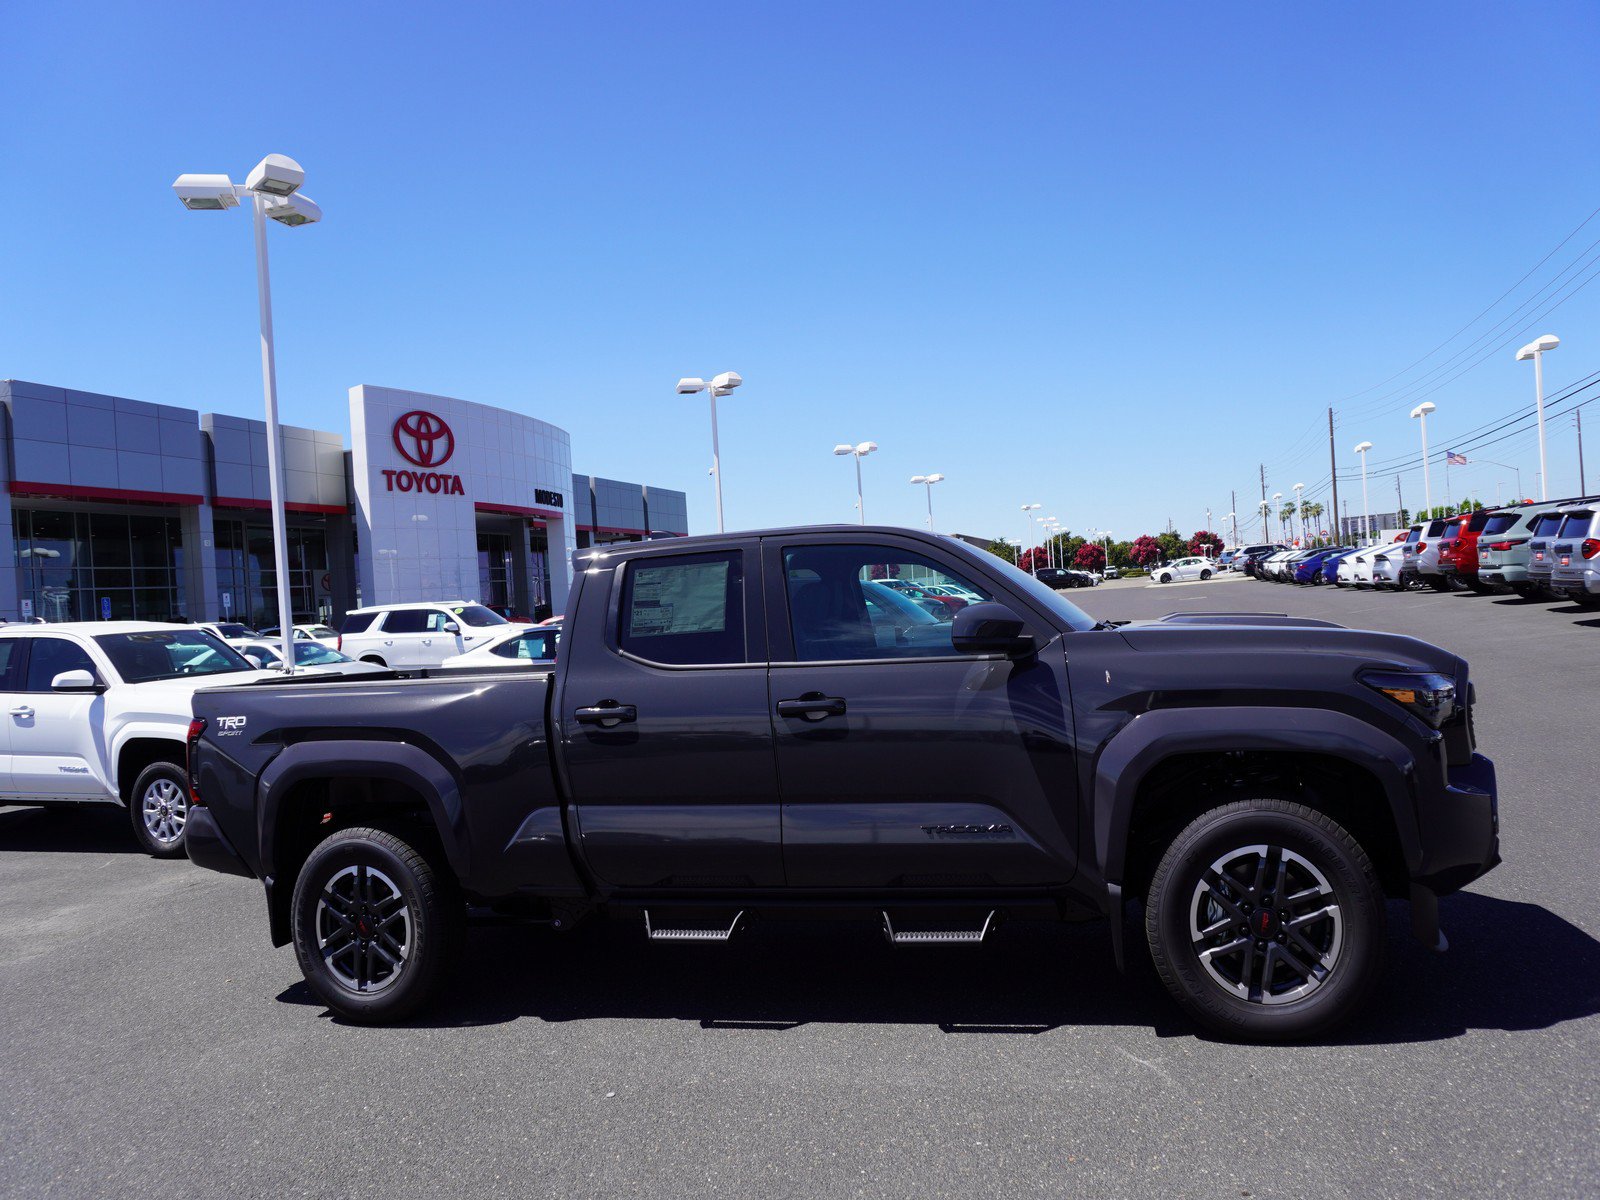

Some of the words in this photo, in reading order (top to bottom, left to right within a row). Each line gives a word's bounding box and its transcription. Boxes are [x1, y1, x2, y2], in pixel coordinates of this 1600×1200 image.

[382, 469, 465, 496] TOYOTA
[534, 488, 563, 509] MODESTO
[216, 715, 247, 729] TRD
[920, 824, 1013, 835] TACOMA
